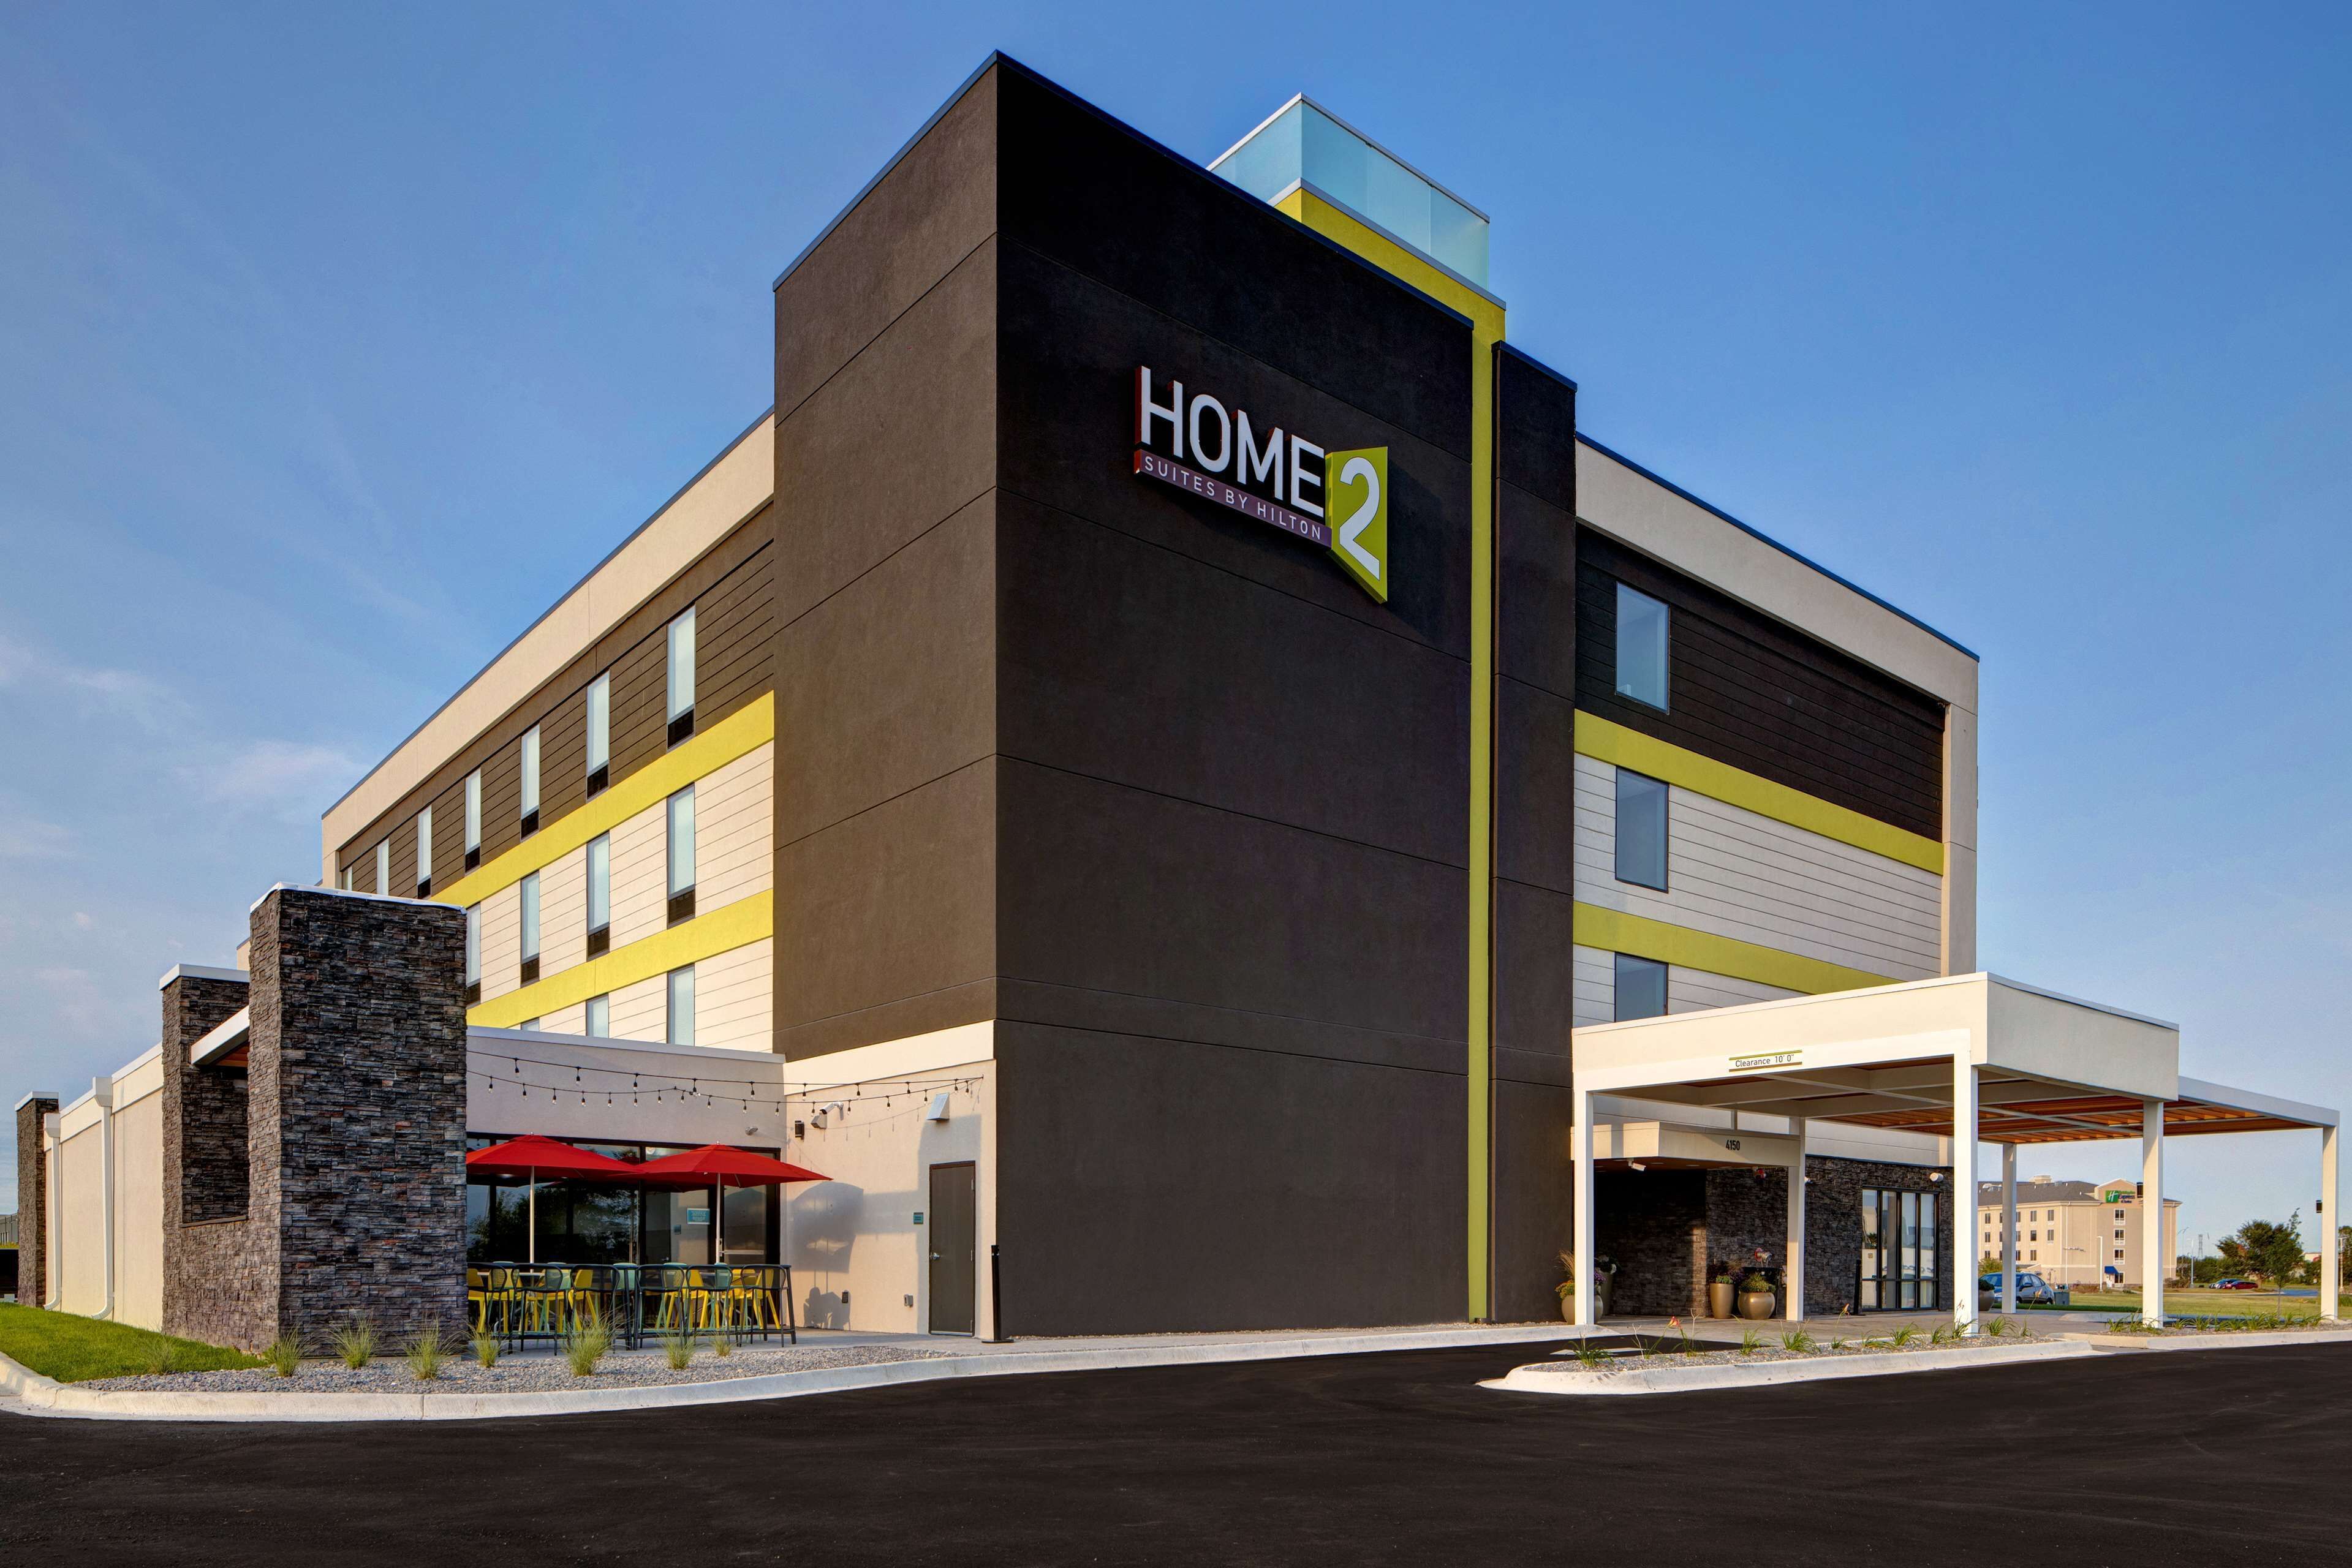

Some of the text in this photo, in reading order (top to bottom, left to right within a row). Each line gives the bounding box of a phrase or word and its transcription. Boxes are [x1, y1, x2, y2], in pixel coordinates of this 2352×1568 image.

[1144, 456, 1321, 540] SUITES BY HILTON
[1735, 1059, 1771, 1068] Clearance
[1725, 1139, 1741, 1151] 4150
